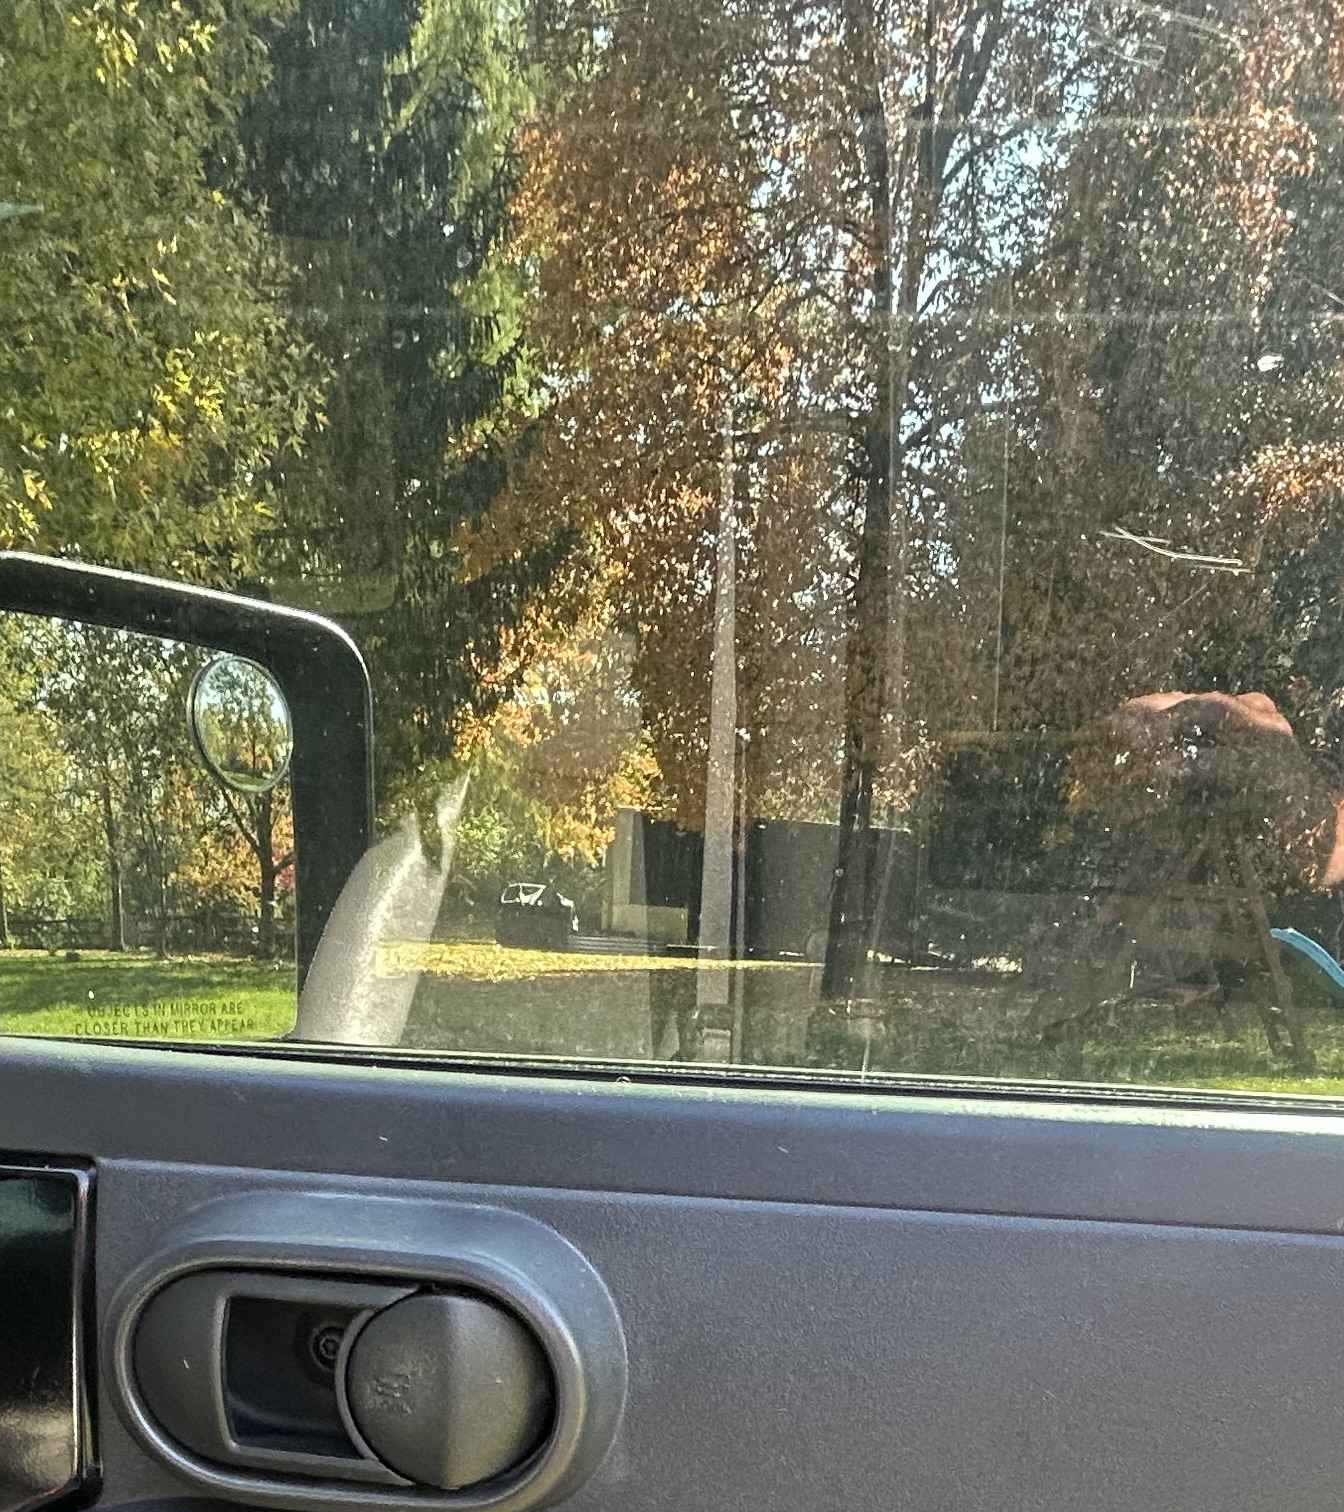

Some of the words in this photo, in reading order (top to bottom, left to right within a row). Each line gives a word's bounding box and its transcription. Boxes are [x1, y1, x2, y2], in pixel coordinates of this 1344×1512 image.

[88, 1002, 149, 1018] OBJECTS
[153, 1002, 166, 1016] IN
[170, 1001, 217, 1016] MIRROR
[221, 1000, 244, 1014] ARE
[74, 1021, 128, 1036] CLOSER
[134, 1020, 169, 1035] THAN
[174, 1019, 205, 1034] THEY
[209, 1018, 255, 1033] APPEAR
